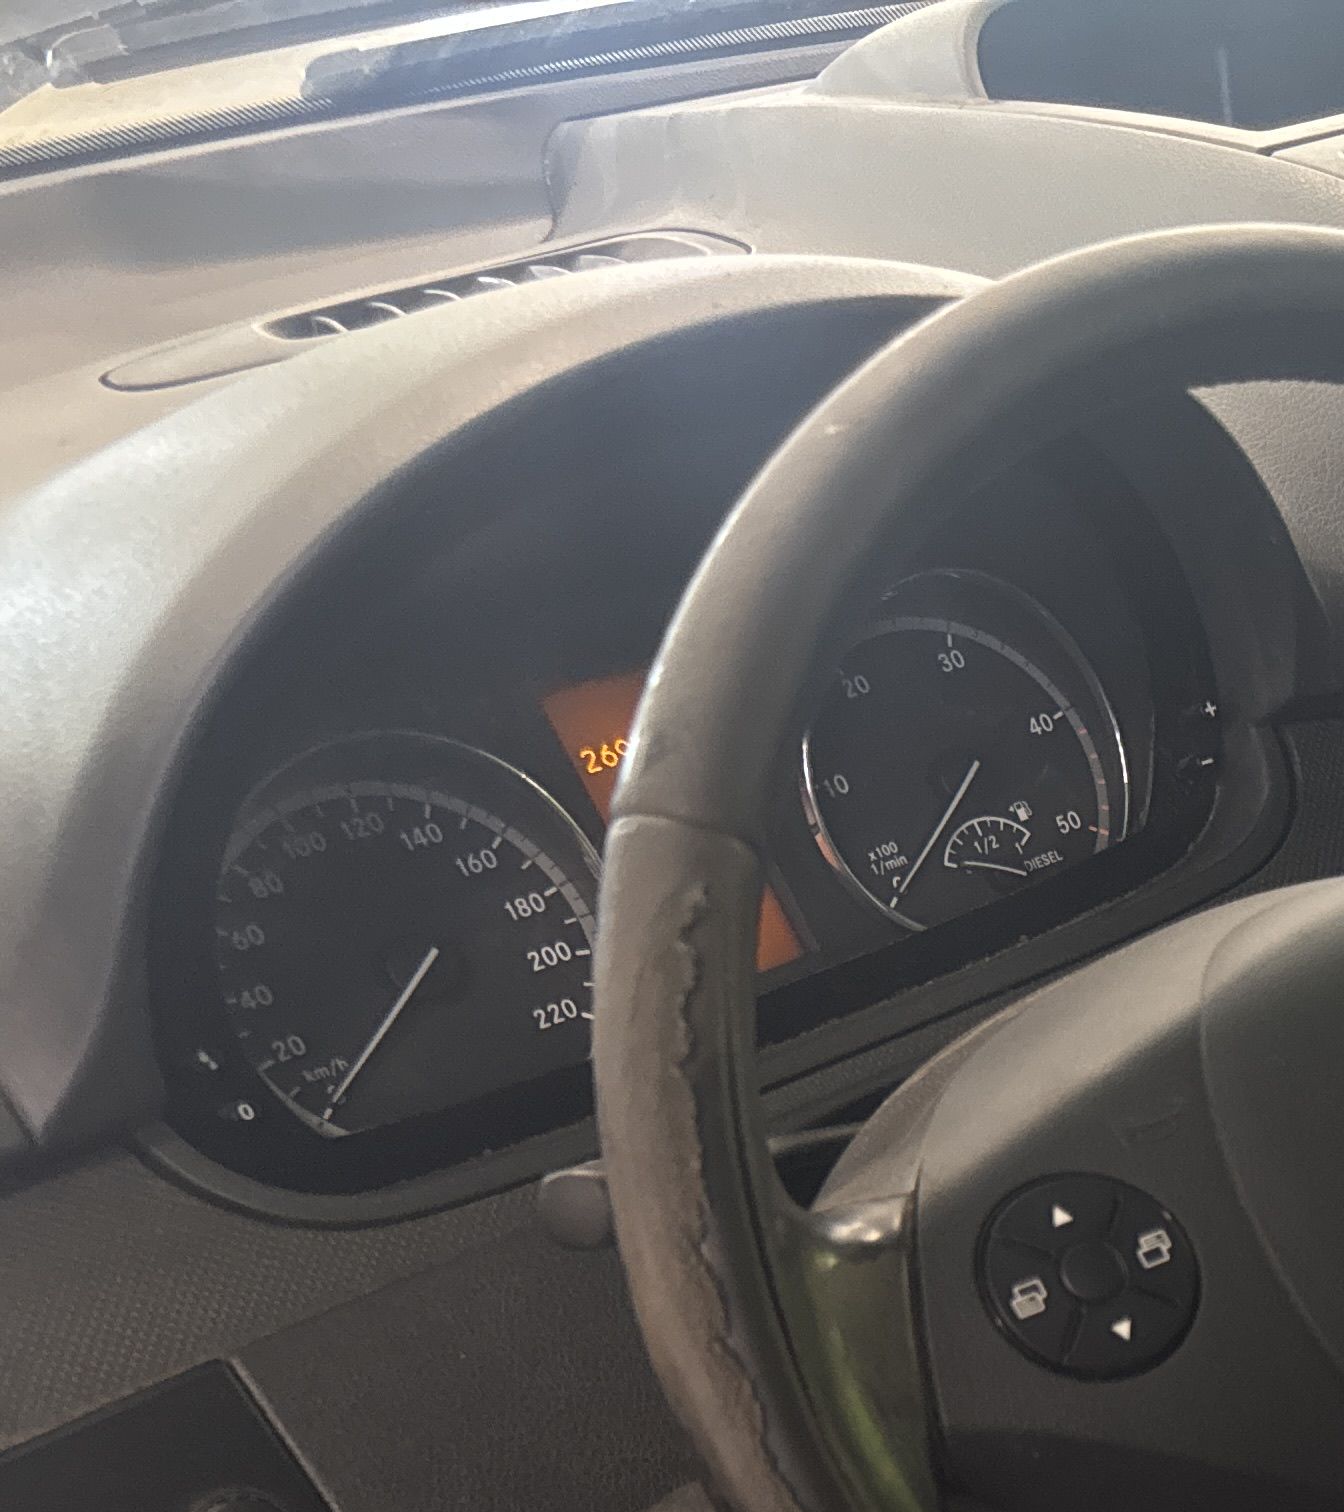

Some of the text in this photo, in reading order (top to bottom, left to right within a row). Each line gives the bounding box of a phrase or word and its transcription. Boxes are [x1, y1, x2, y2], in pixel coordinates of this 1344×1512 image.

[937, 650, 965, 673] 30
[842, 674, 871, 699] 20
[1029, 713, 1054, 736] 40
[823, 773, 850, 798] 10
[340, 811, 385, 841] 120
[1055, 810, 1082, 834] 50
[400, 822, 444, 851] 140
[974, 835, 1000, 855] 1/2
[455, 848, 498, 878] 160
[867, 841, 899, 862] x100
[1023, 849, 1064, 873] DIESEL
[869, 855, 909, 877] 1/min
[503, 892, 546, 920] 180
[526, 941, 572, 972] 200
[240, 984, 273, 1010] 40
[533, 999, 578, 1029] 220
[272, 1035, 306, 1063] 20
[301, 1057, 350, 1083] km/h
